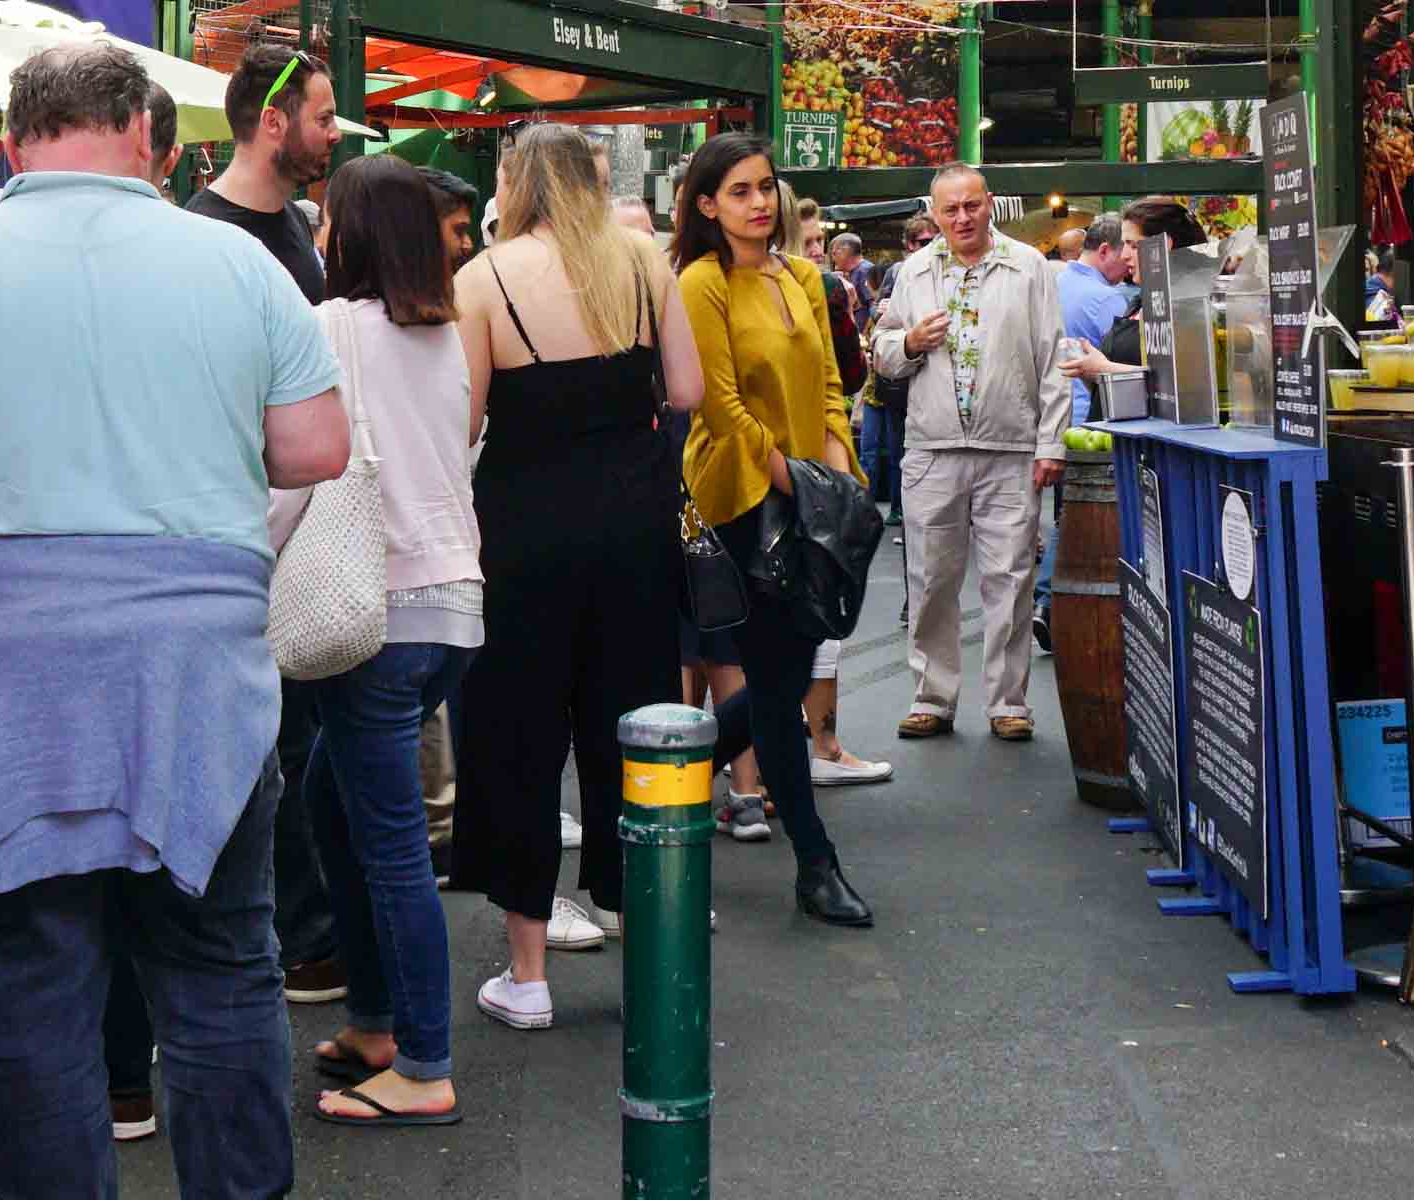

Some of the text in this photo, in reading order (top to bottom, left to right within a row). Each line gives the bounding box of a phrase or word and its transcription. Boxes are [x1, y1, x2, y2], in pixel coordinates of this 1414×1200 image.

[553, 17, 620, 54] Elsey & Bent
[1147, 75, 1190, 92] Turnips
[786, 111, 837, 125] TURNIPS
[645, 128, 663, 140] lets
[1338, 705, 1393, 719] 234225
